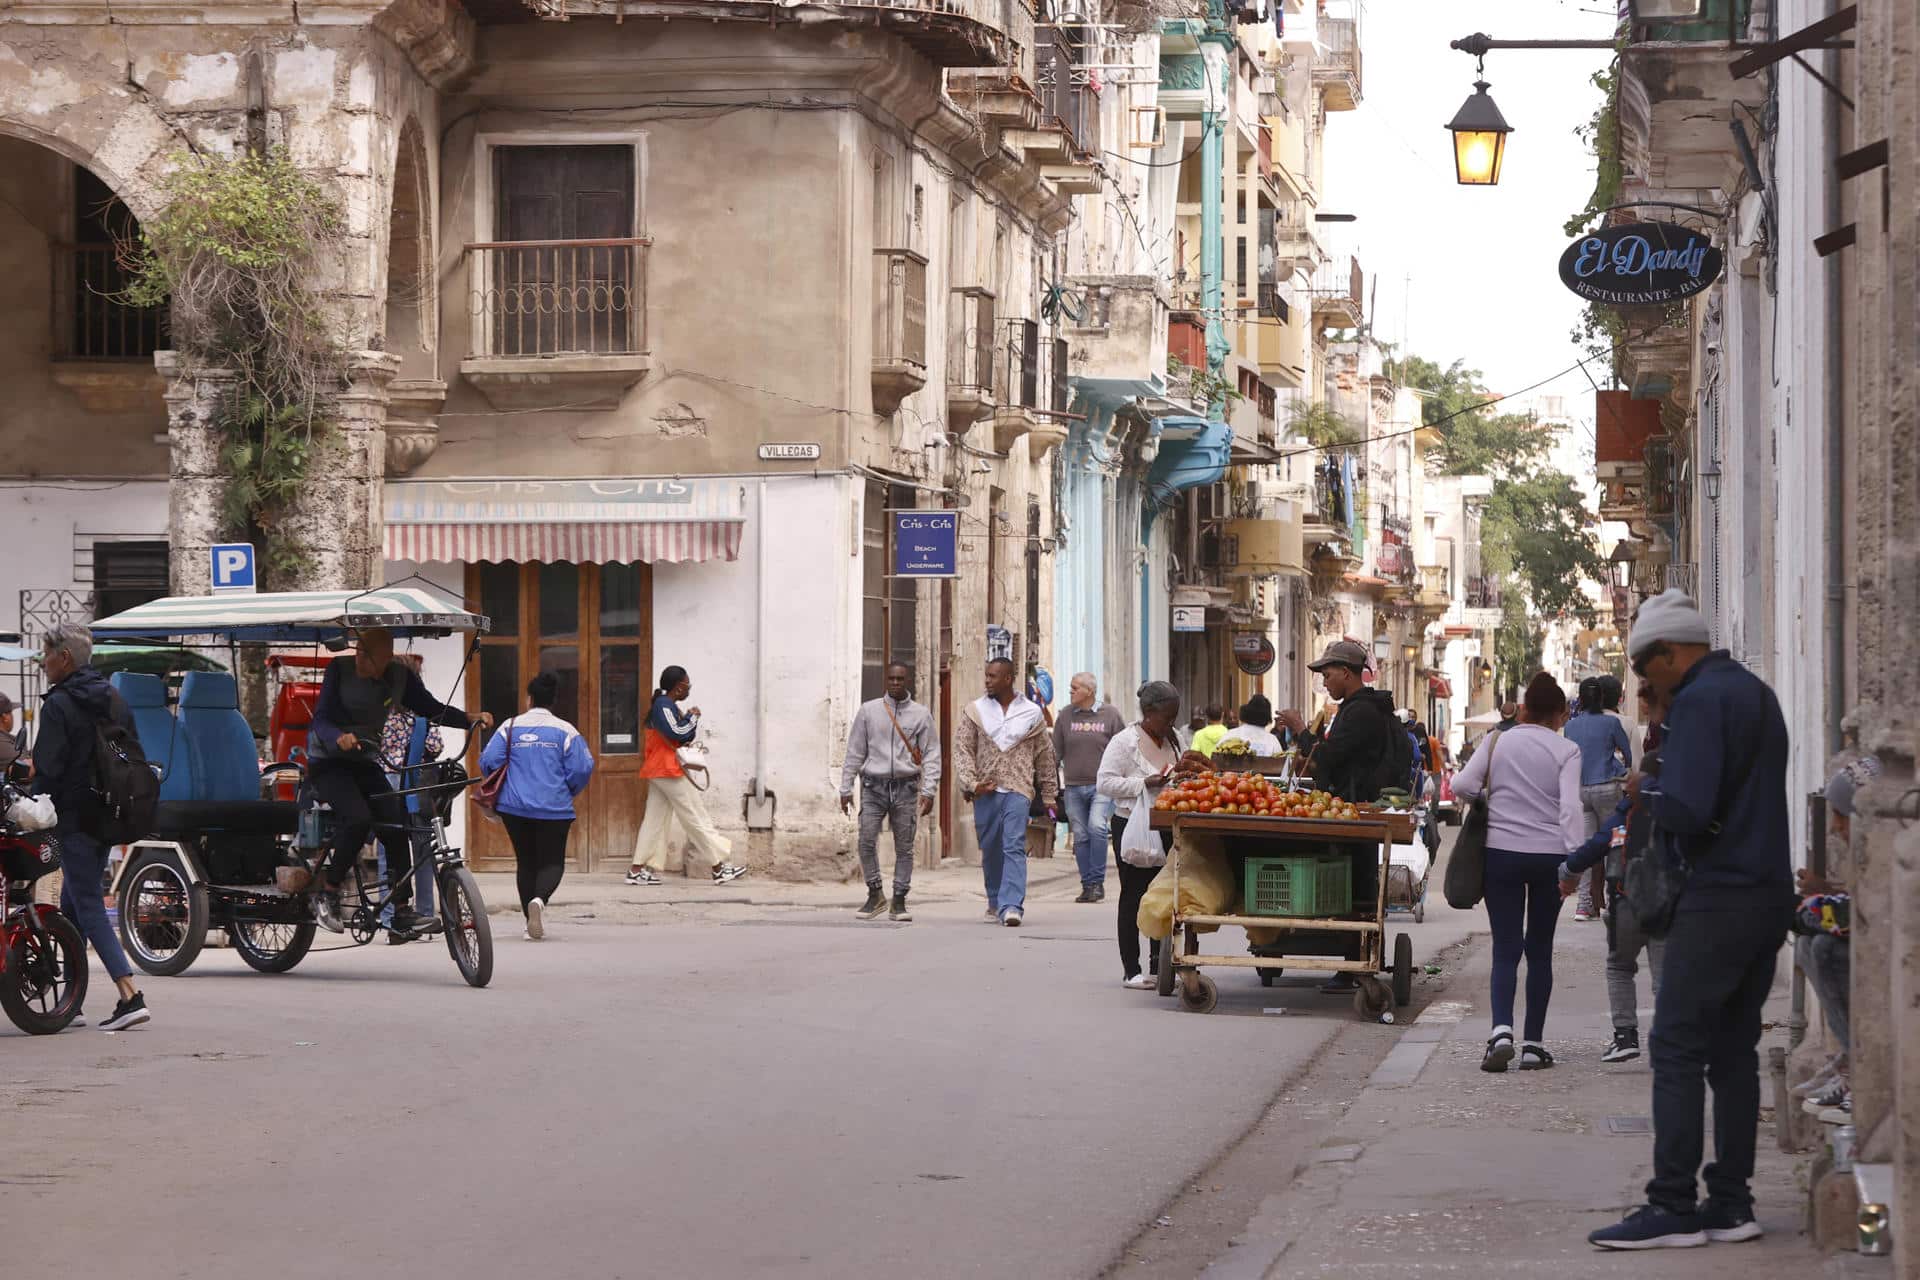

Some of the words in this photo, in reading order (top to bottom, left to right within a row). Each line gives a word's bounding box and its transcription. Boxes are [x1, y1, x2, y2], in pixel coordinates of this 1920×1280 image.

[1574, 237, 1611, 277] El
[1612, 235, 1708, 277] Dandy
[1576, 280, 1672, 304] RESTAURANTE
[765, 446, 813, 457] VILLEGAS
[900, 519, 922, 528] Cris
[930, 520, 952, 528] Cris
[218, 550, 247, 584] P
